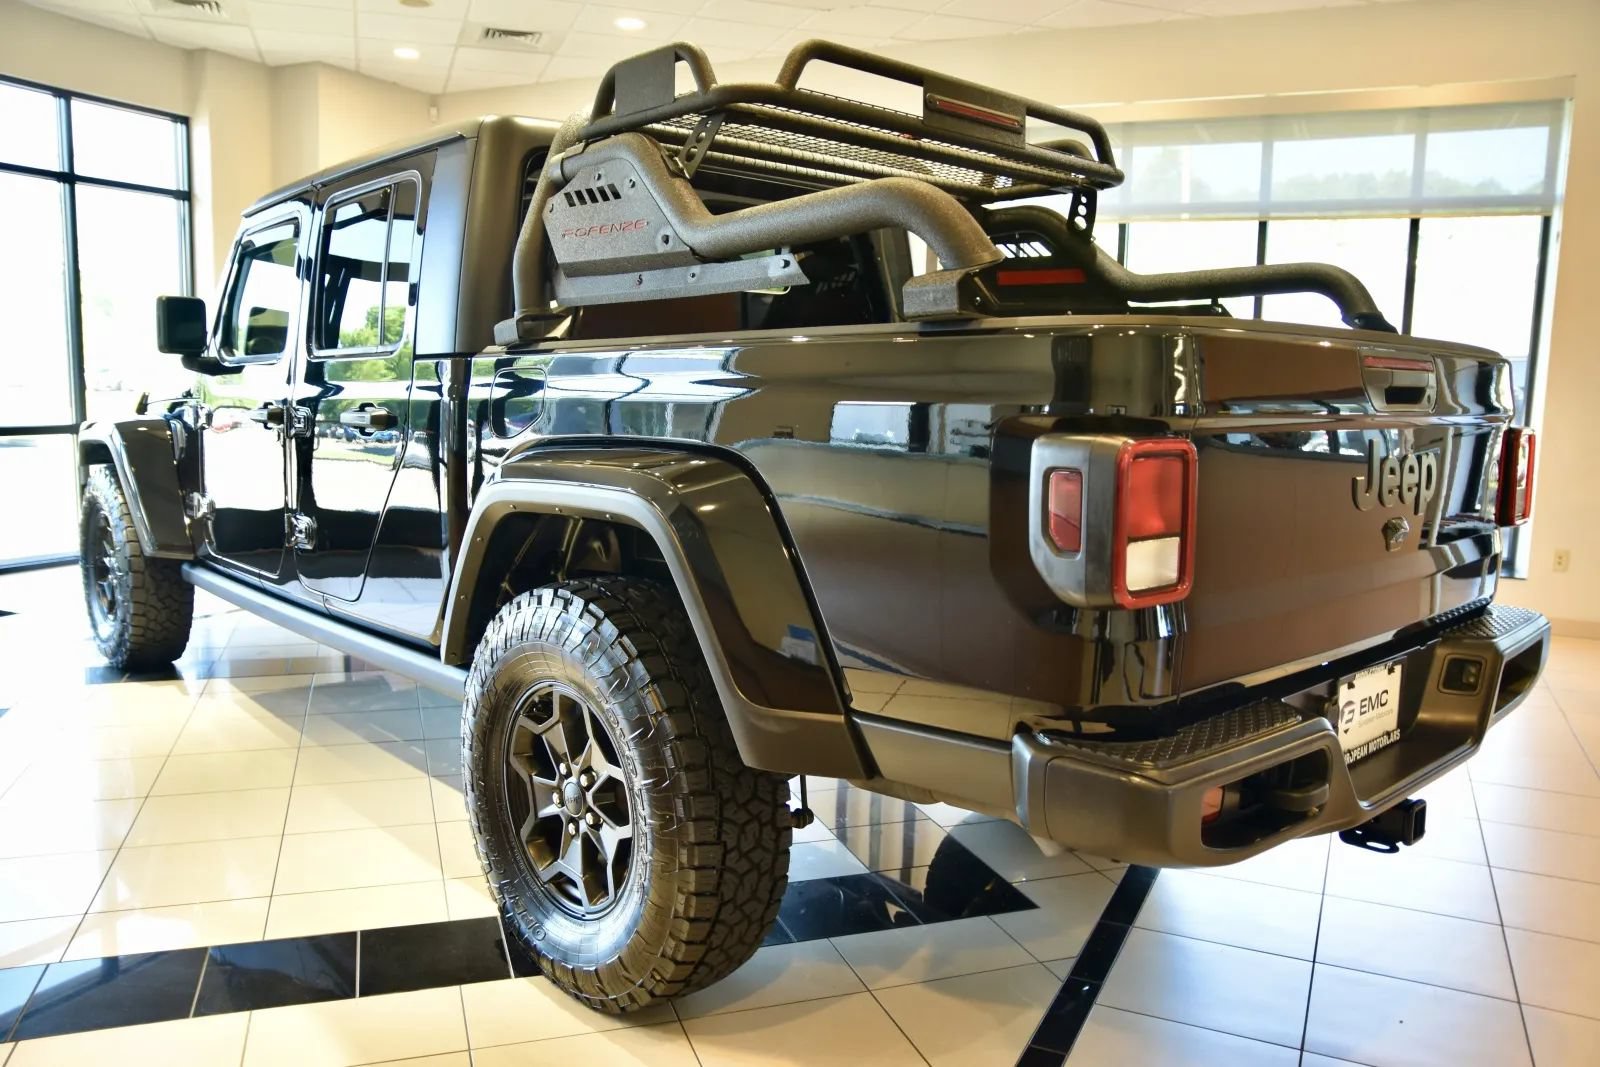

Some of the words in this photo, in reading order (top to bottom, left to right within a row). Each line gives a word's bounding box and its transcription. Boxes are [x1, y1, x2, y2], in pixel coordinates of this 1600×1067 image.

[1352, 438, 1437, 516] Jeep
[1359, 689, 1389, 717] EMC
[1344, 743, 1369, 765] ROPEAN
[499, 879, 547, 942] OPEN
